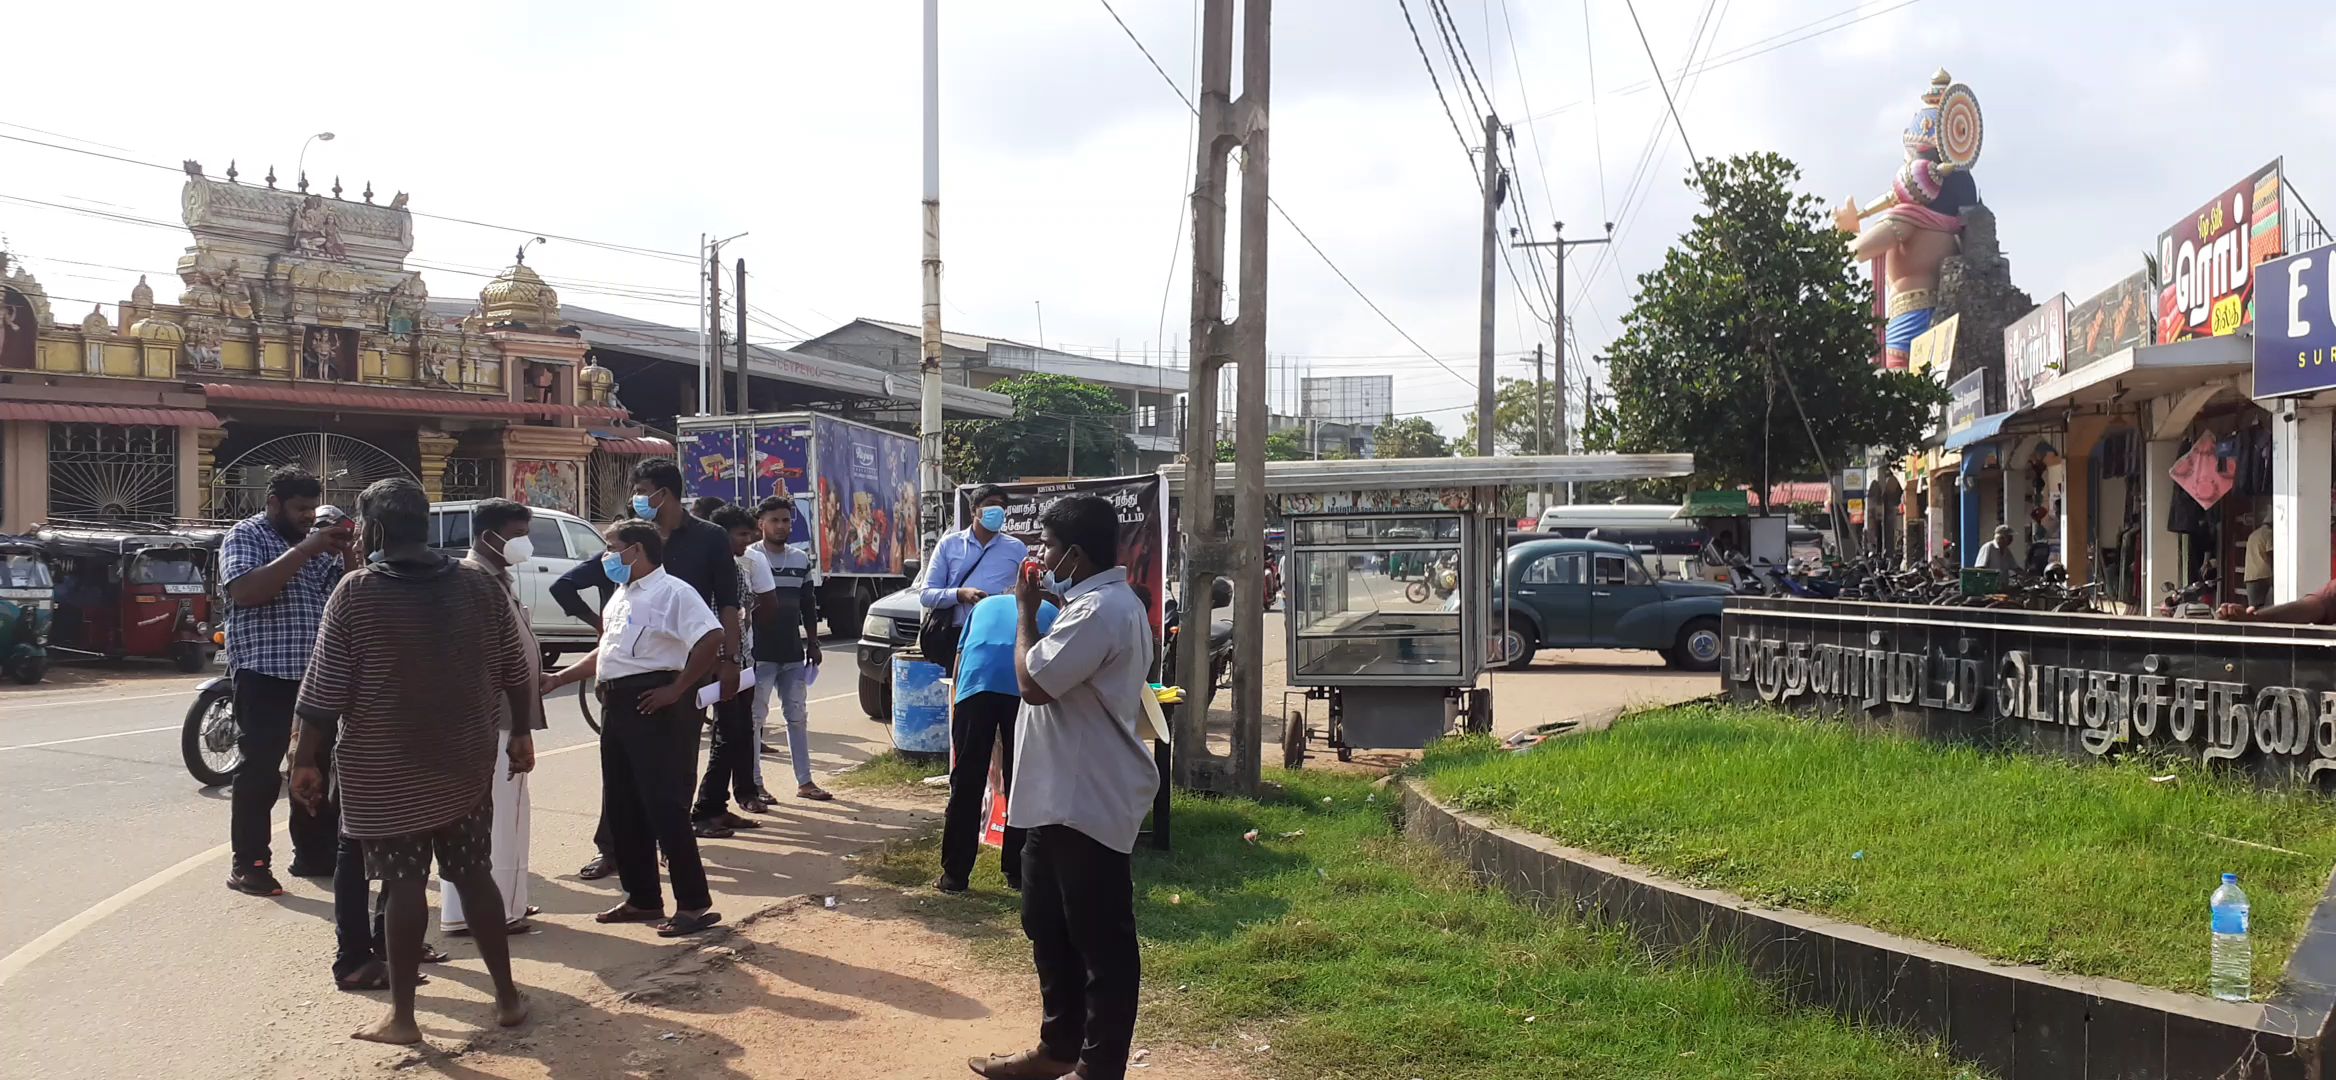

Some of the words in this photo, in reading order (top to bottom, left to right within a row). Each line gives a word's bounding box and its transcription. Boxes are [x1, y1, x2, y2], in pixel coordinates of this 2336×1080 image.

[2197, 213, 2210, 243] Top
[2210, 200, 2224, 236] Silk
[1037, 486, 1056, 494] JUSTICE
